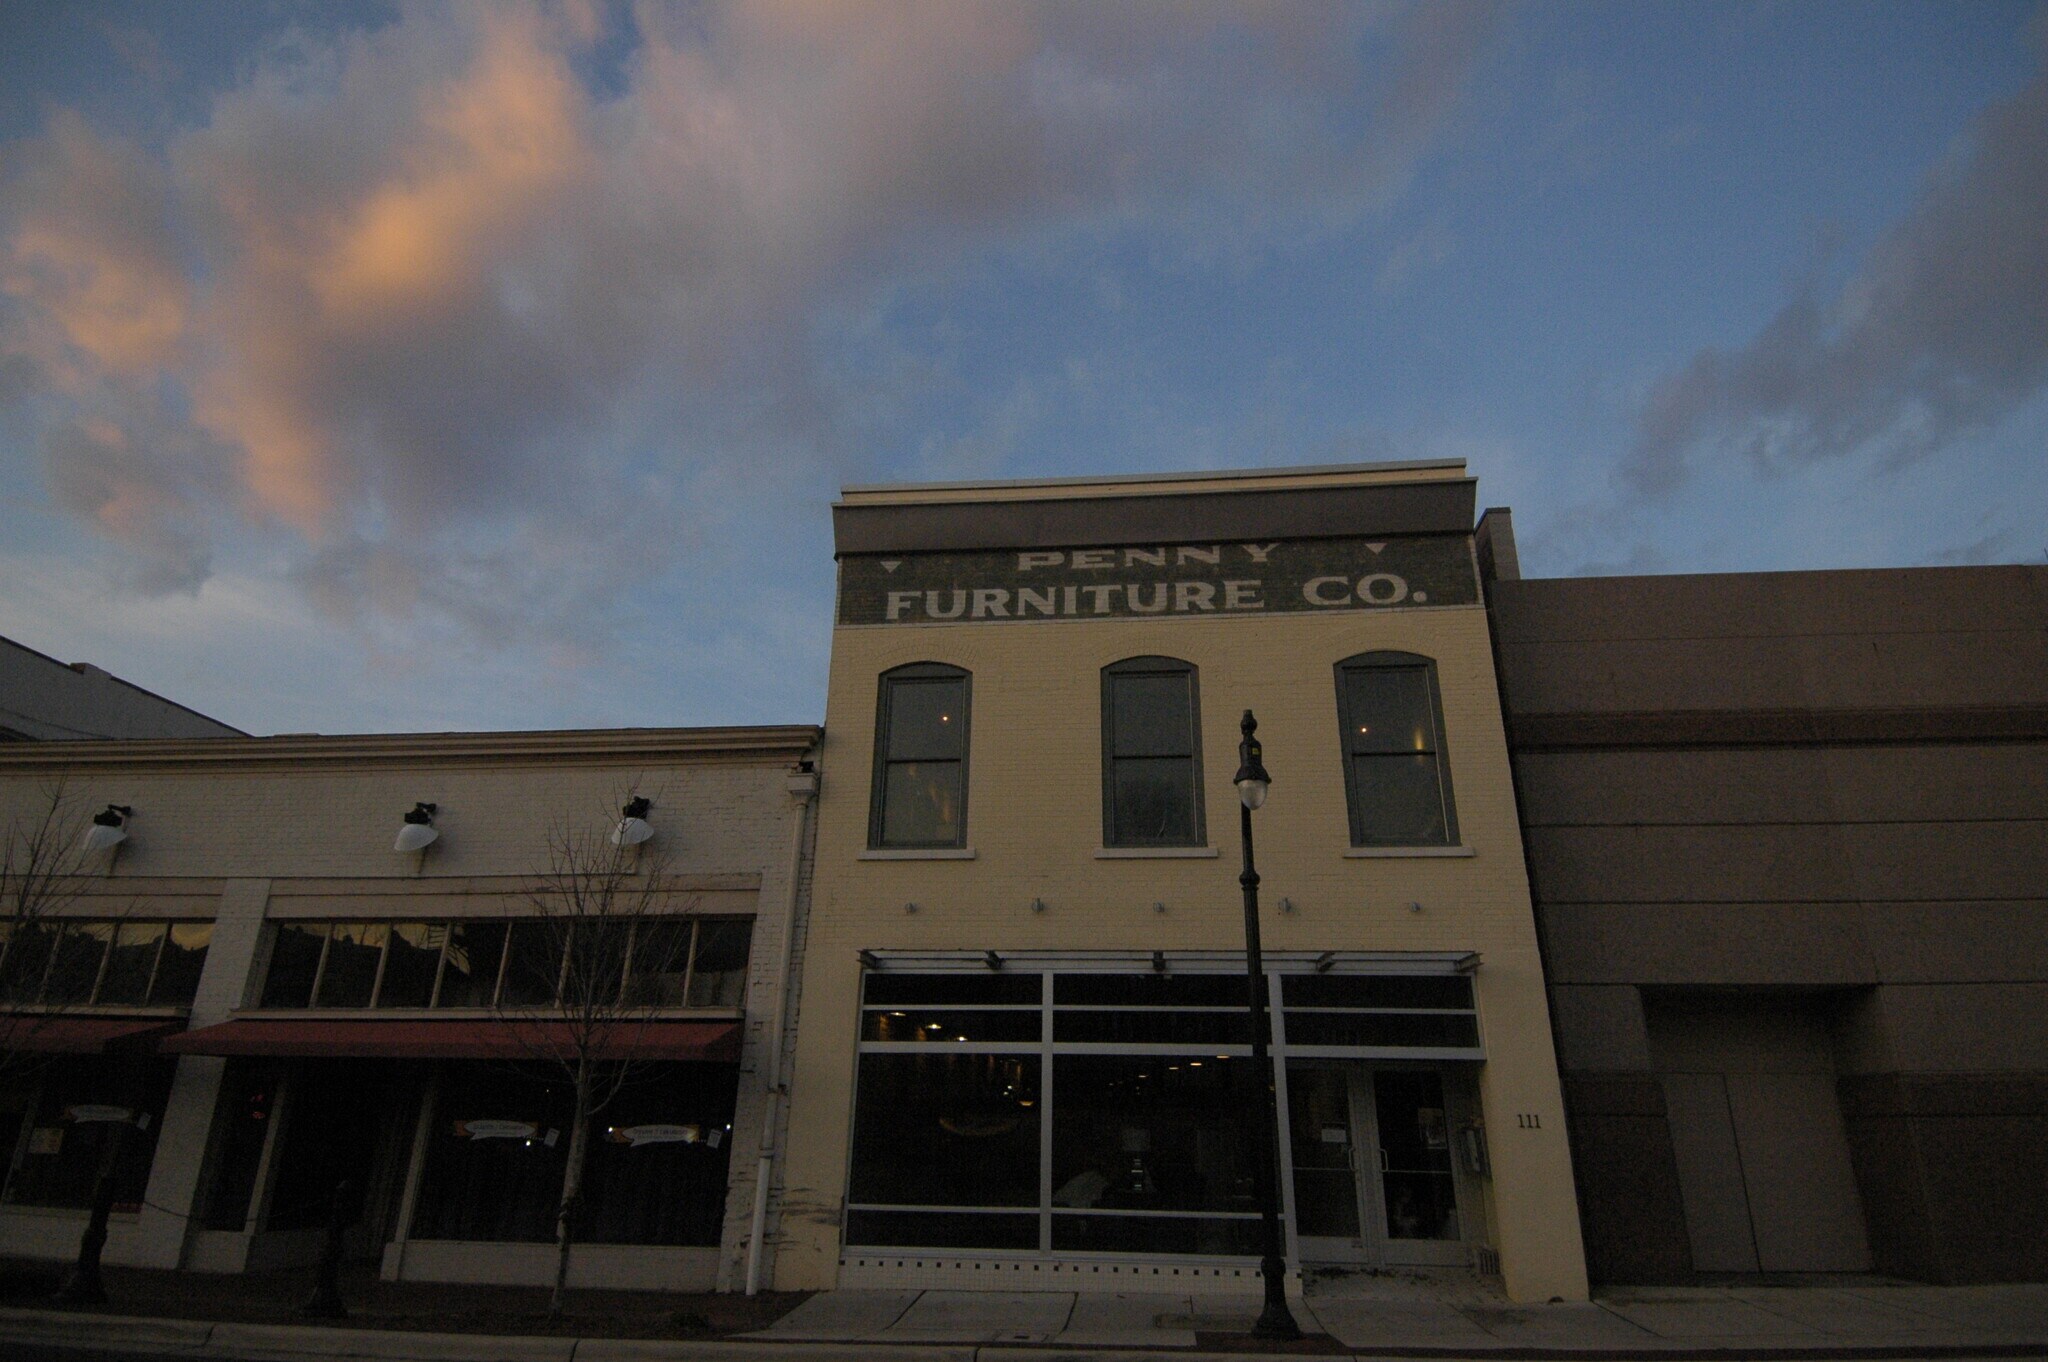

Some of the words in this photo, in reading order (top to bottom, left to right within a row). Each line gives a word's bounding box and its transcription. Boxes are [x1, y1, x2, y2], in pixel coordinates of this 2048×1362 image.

[1016, 542, 1280, 571] PENNY
[886, 579, 1265, 620] FURNITURE
[1302, 573, 1428, 607] CO.
[1516, 1113, 1542, 1129] 111
